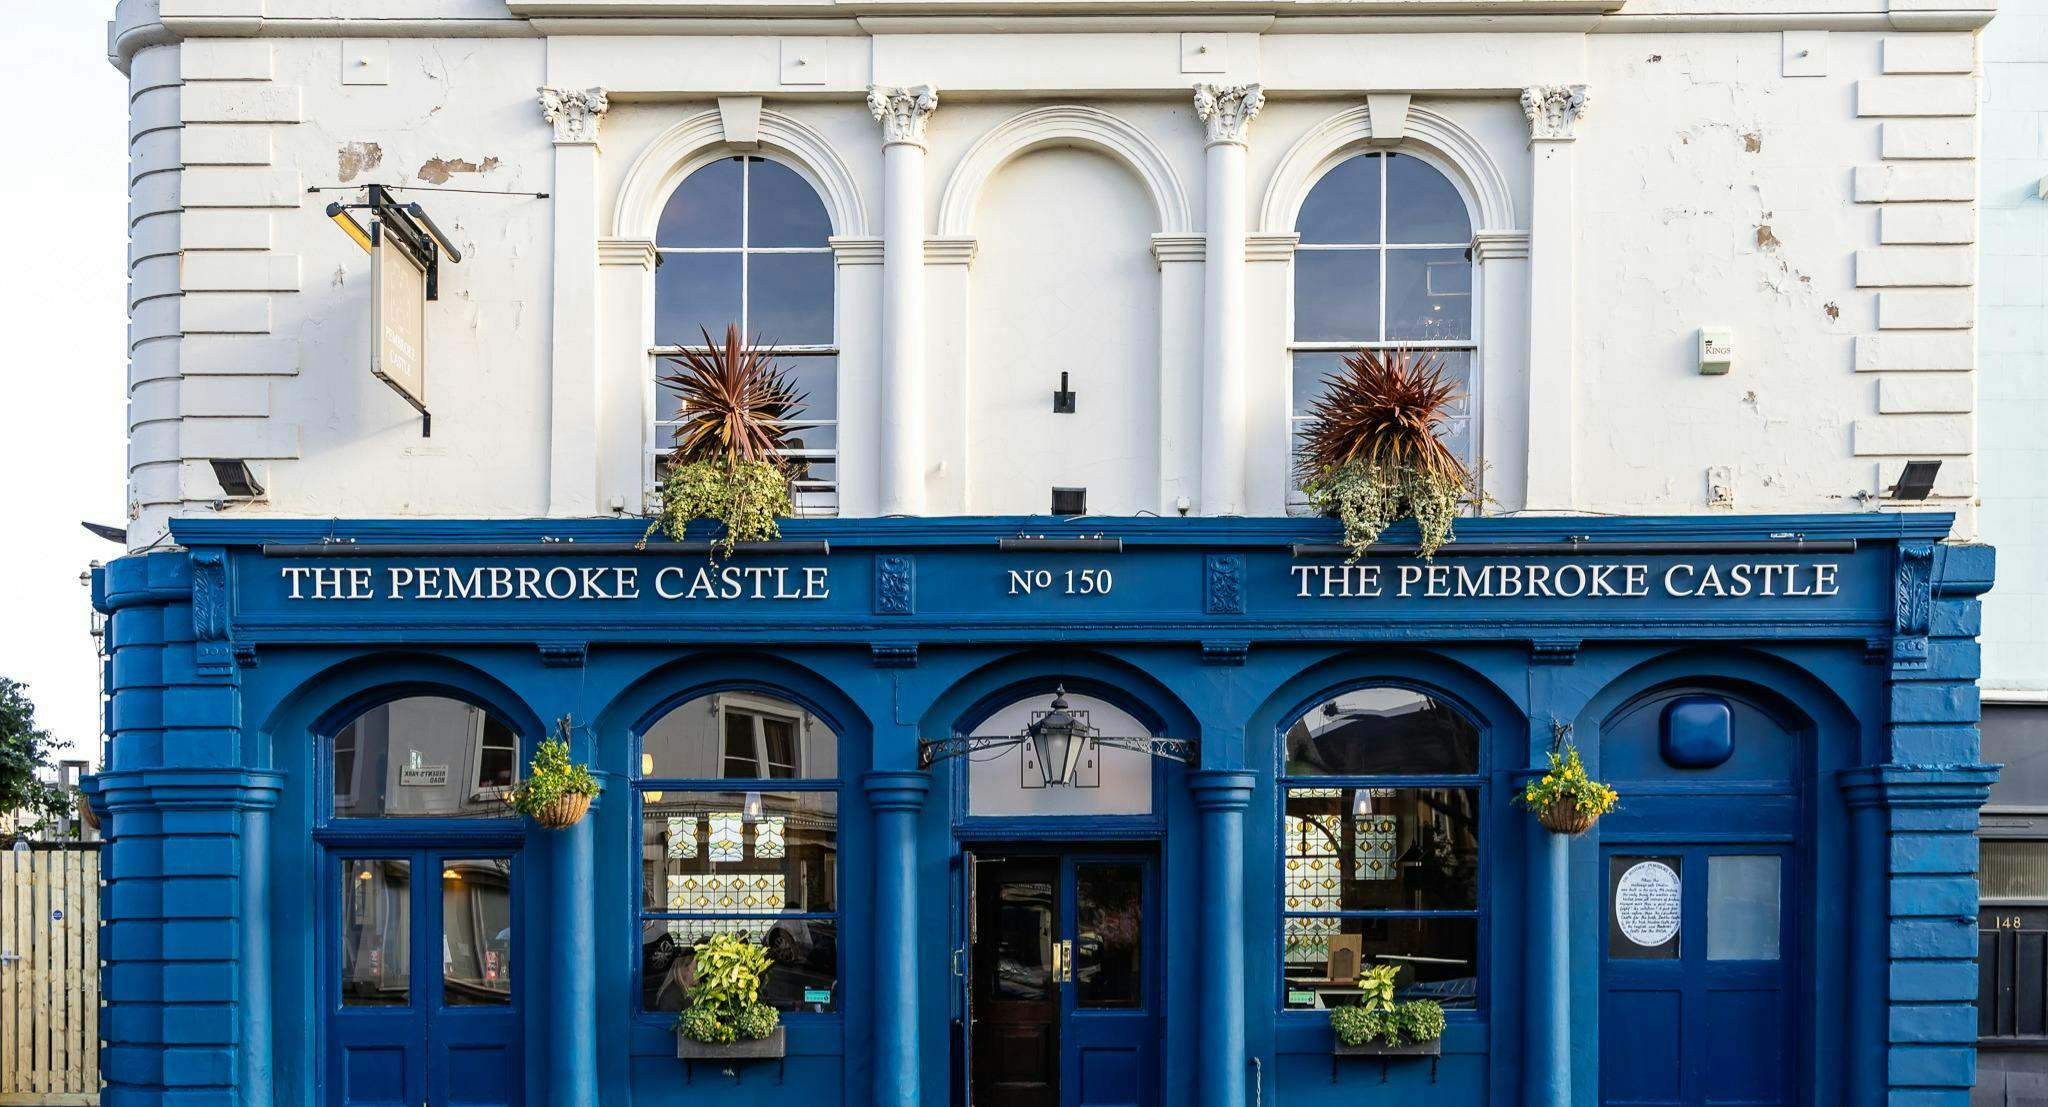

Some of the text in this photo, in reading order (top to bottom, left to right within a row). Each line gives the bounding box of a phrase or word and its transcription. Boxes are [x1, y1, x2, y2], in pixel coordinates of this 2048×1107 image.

[1705, 346, 1731, 354] KINGS
[281, 566, 830, 600] THE PEMBROKE CASTLE
[1065, 569, 1113, 595] 150
[1291, 563, 1840, 599] THE PEMBROKE CASTLE
[1996, 915, 2021, 929] 148
